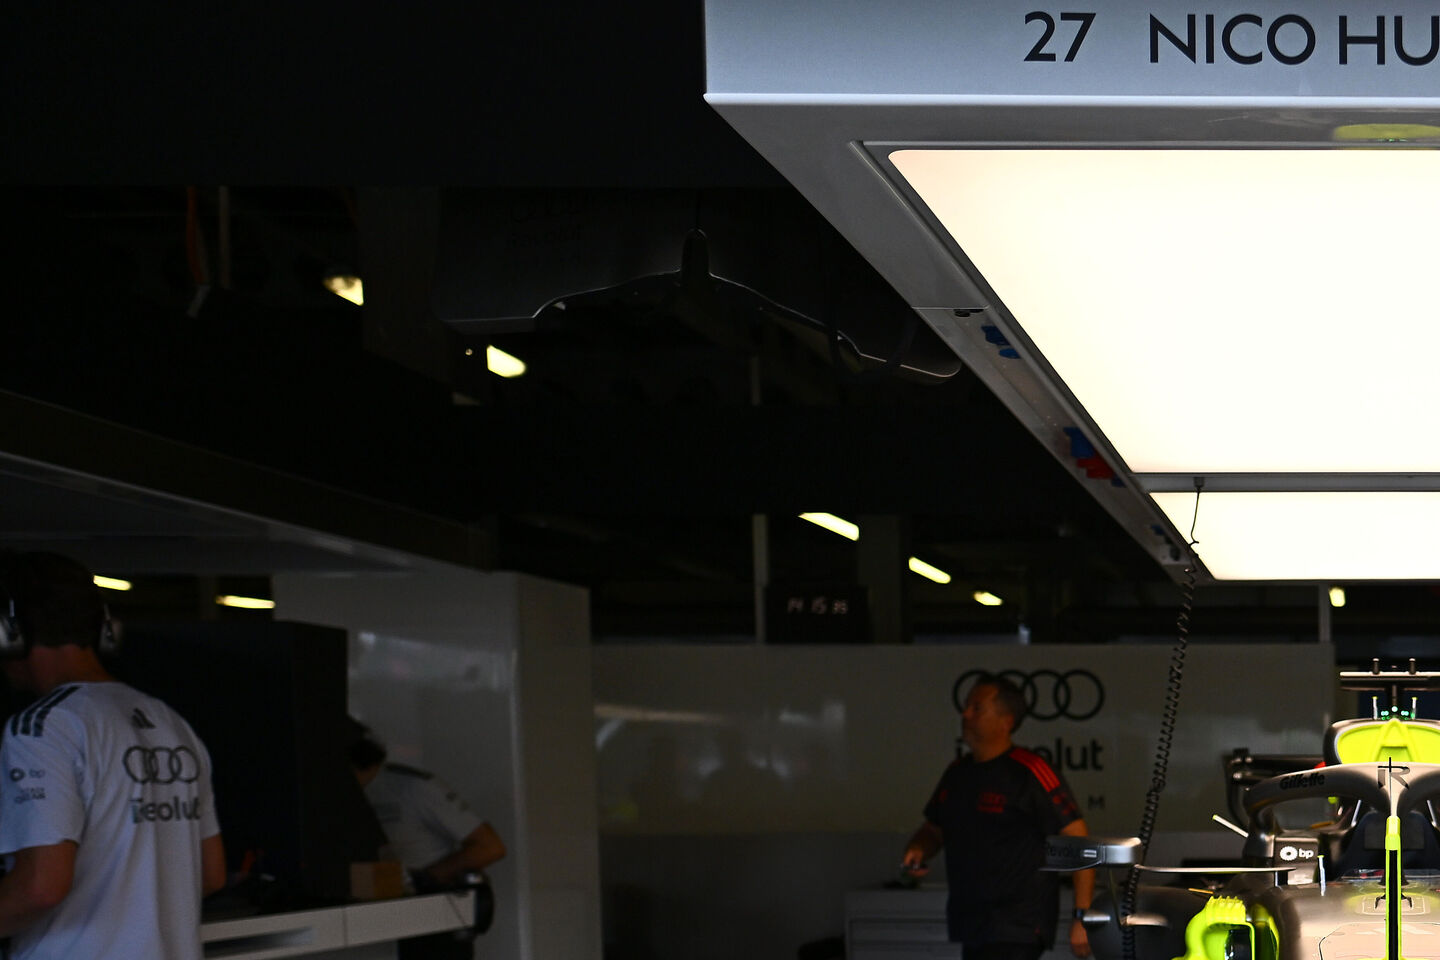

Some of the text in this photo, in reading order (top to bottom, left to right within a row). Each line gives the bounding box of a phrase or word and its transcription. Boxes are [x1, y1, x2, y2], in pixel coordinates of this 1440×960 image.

[1024, 12, 1096, 62] 27
[1150, 14, 1316, 64] NICO
[1280, 773, 1325, 790] Gillette
[1299, 848, 1314, 859] bp
